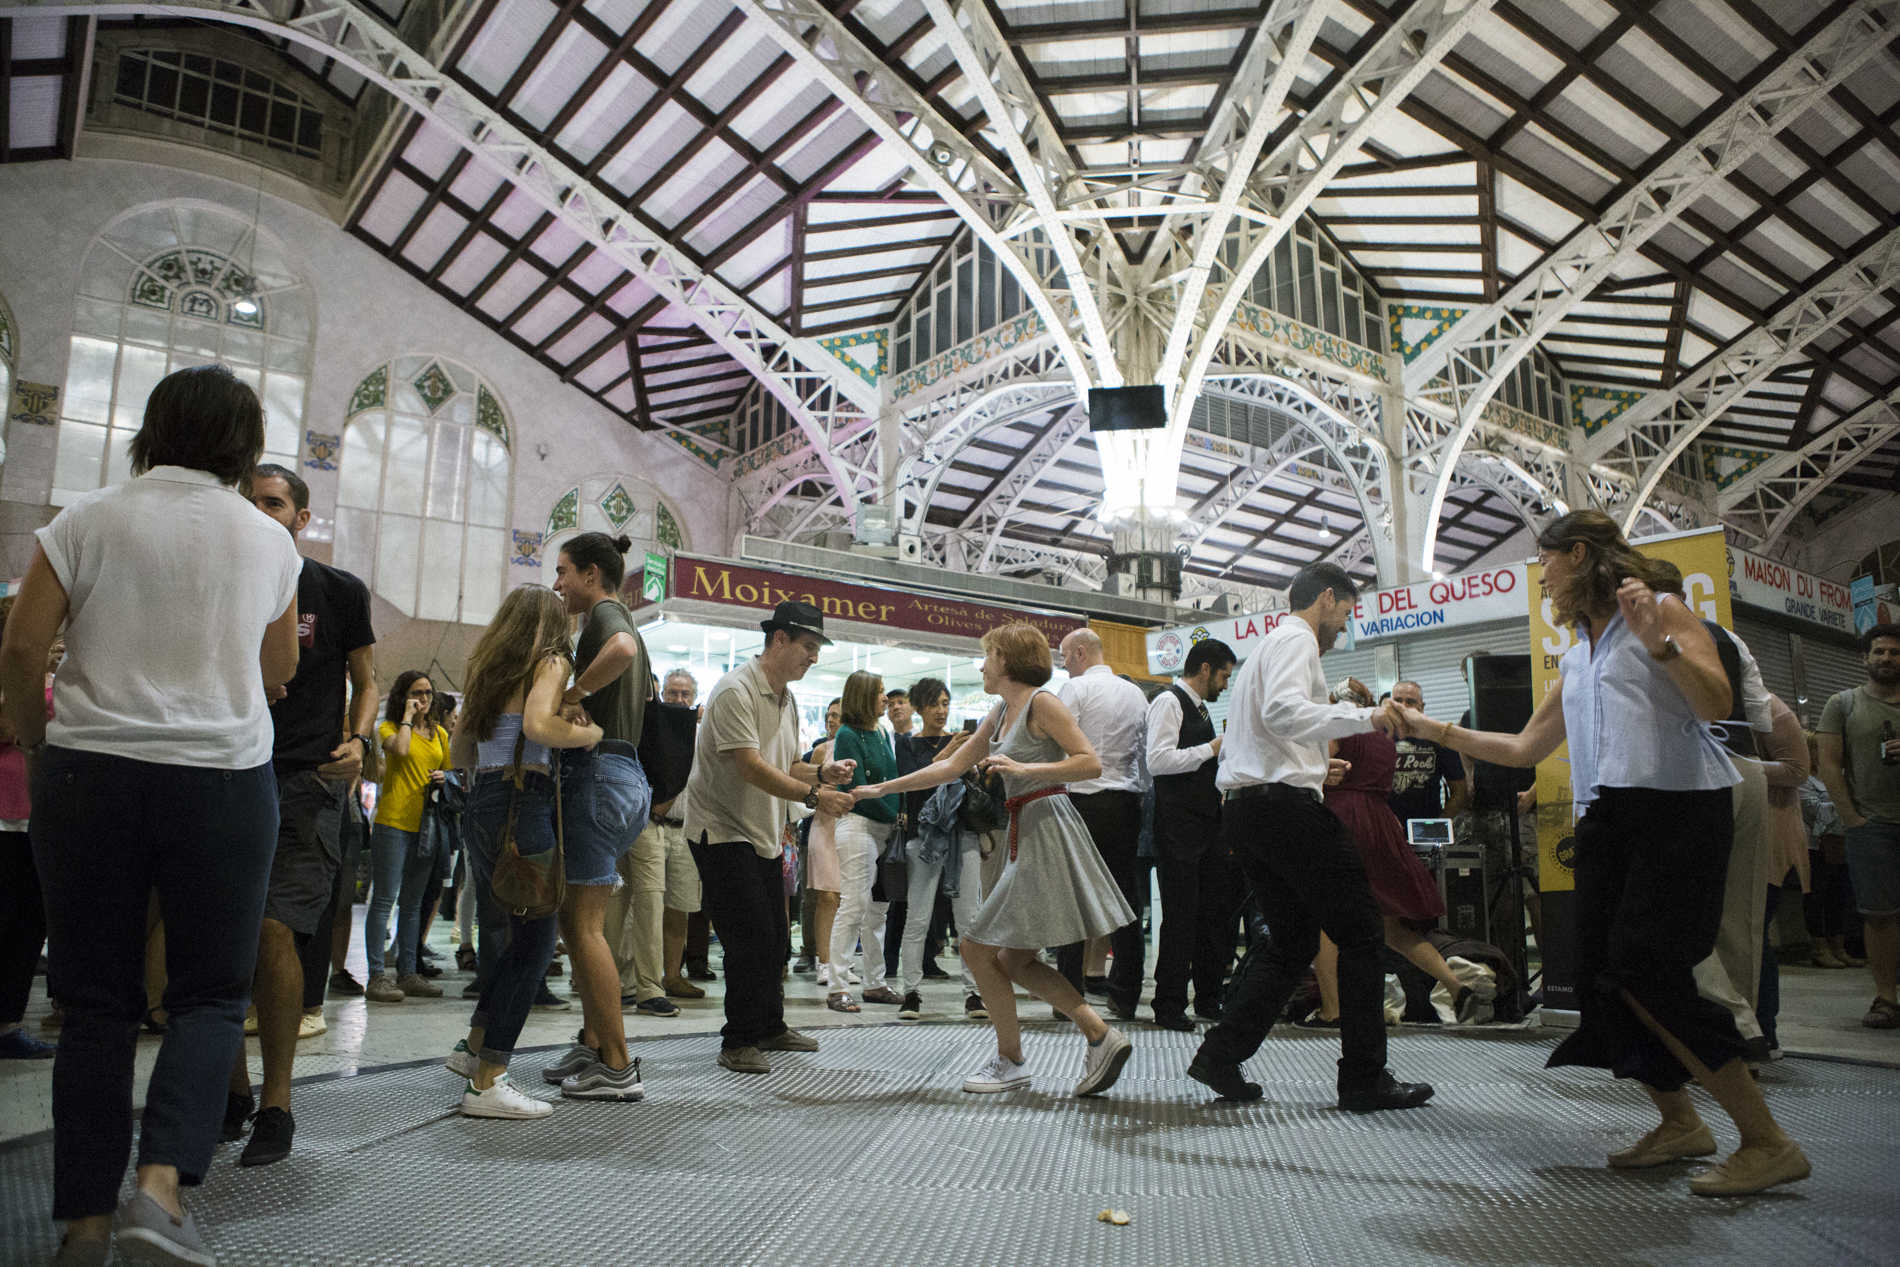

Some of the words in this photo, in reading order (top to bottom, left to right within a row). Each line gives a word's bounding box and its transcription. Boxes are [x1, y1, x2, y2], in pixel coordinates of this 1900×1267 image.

[1744, 555, 1791, 593] MAISON
[1797, 574, 1814, 599] DU
[690, 566, 896, 622] Moixamer
[1234, 619, 1259, 641] LA
[1378, 588, 1418, 614] DEL
[1429, 569, 1516, 605] QUESO
[927, 614, 983, 631] Olives
[975, 608, 995, 621] de
[1360, 609, 1445, 636] VARIACION
[1785, 597, 1817, 621] GRANDE
